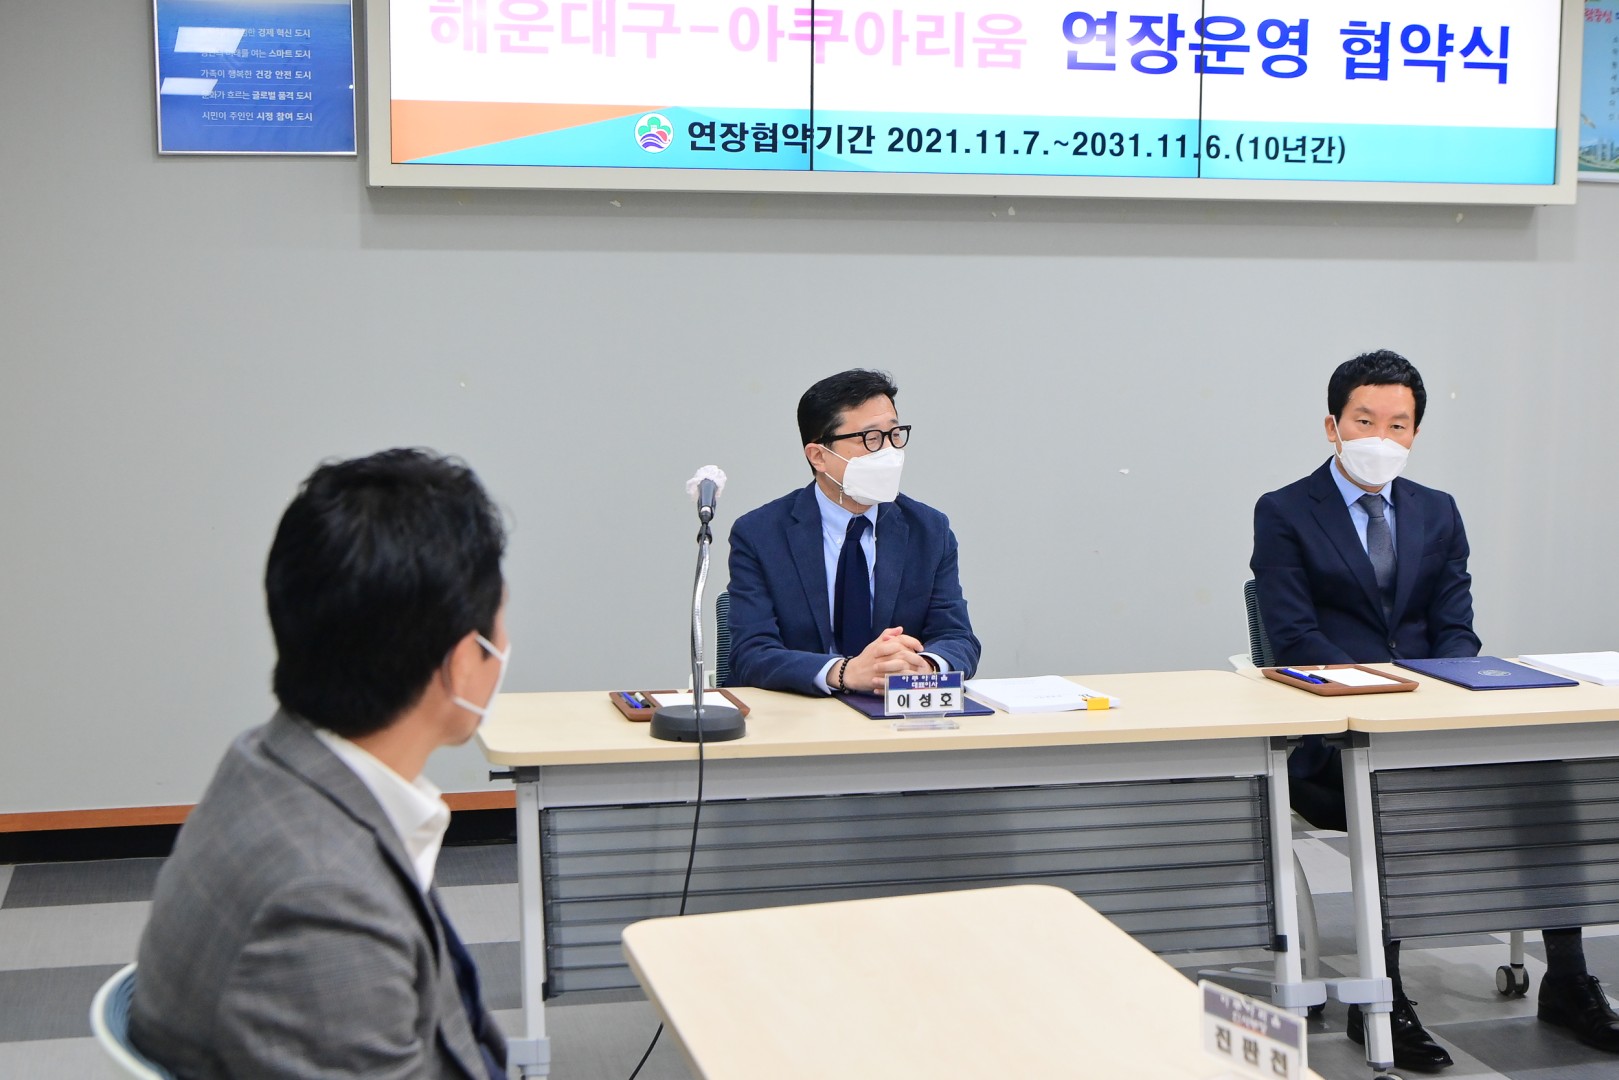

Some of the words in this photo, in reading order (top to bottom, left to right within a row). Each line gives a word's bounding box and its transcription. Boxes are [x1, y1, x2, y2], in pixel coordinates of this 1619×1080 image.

[258, 28, 274, 37] 경제
[276, 28, 292, 37] 혁신
[294, 28, 310, 38] 도시
[1062, 11, 1309, 78] 연장운영
[1340, 20, 1509, 84] 협약식
[251, 49, 266, 58] 여는
[269, 49, 293, 58] 스마트
[294, 49, 311, 59] 도시
[200, 69, 225, 79] 가족이
[228, 69, 252, 79] 행복한
[256, 70, 272, 79] 건강
[275, 70, 292, 79] 안전
[295, 70, 312, 80] 도시
[227, 91, 250, 99] 흐르는
[252, 91, 276, 100] 글로벌
[278, 91, 294, 100] 품격
[296, 91, 312, 101] 도시
[201, 111, 227, 121] 시민이
[229, 111, 254, 121] 주인인
[257, 112, 274, 121] 시정
[276, 112, 293, 122] 참여
[296, 112, 313, 122] 도시
[687, 120, 876, 155] 연장협약기간
[911, 681, 938, 689] 대표이사
[897, 692, 952, 708] 이성호
